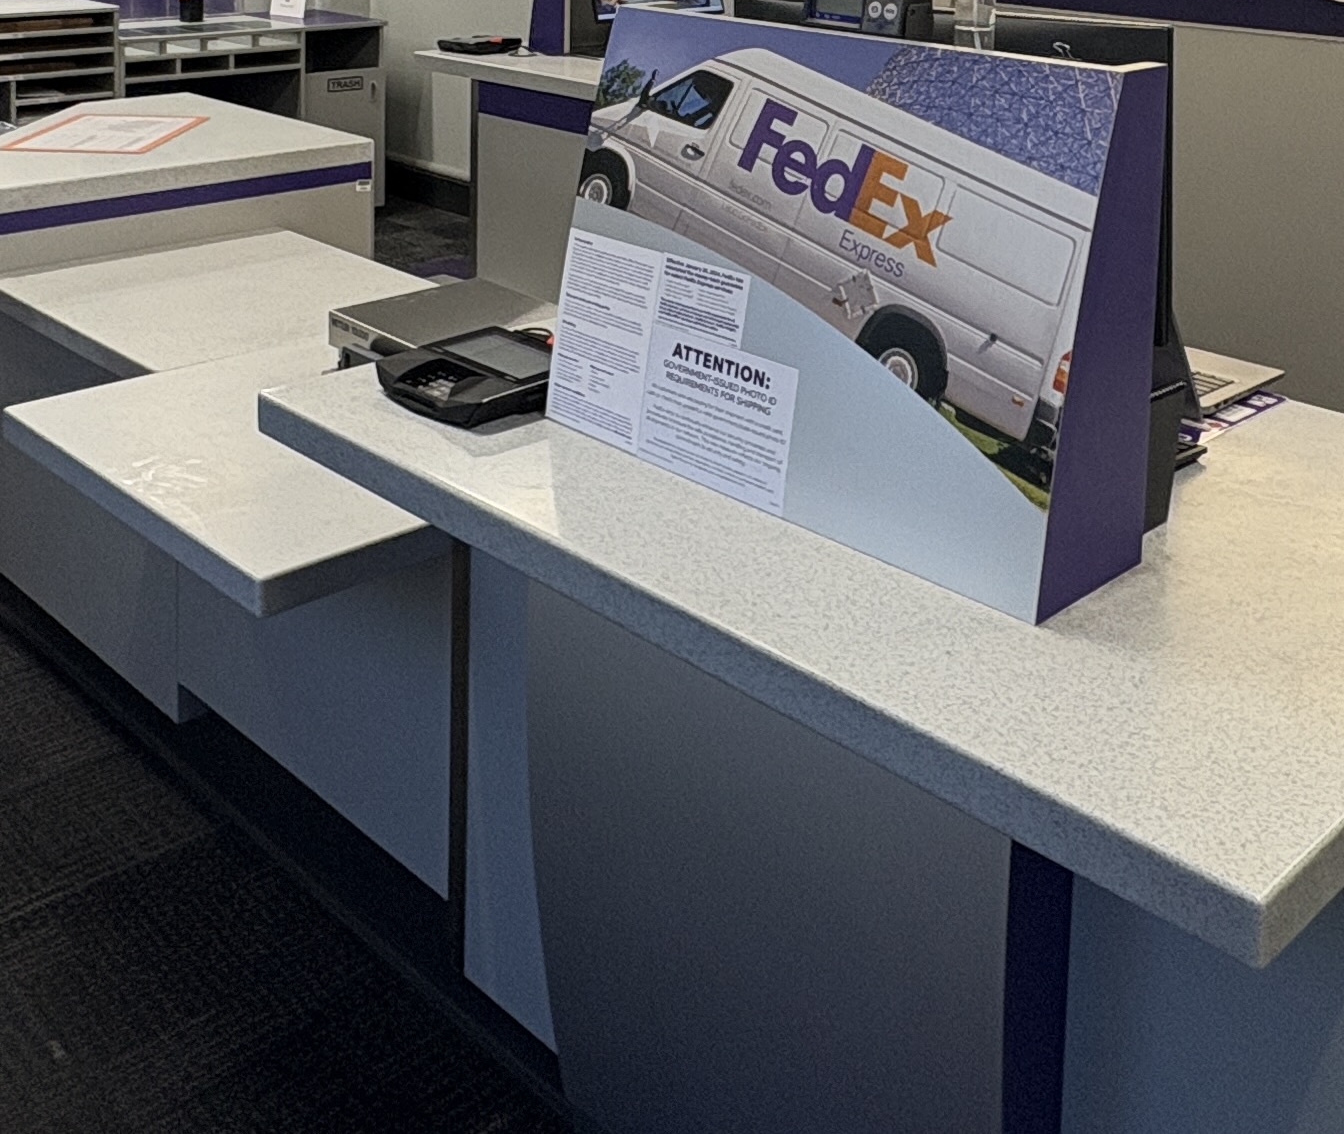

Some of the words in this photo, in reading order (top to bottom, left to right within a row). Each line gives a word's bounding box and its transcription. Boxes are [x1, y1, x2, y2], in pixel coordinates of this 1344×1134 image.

[331, 79, 361, 89] TRASH
[737, 98, 953, 268] FedEx
[838, 229, 905, 278] Express
[664, 358, 740, 393] GOVERNMENT-ISSUED
[740, 387, 768, 403] PHOTO
[768, 395, 778, 406] ID
[672, 342, 771, 390] ATTENTION:
[665, 370, 719, 398] REQUIREMENTS
[719, 391, 736, 404] FOR
[736, 396, 772, 416] SHIPPING
